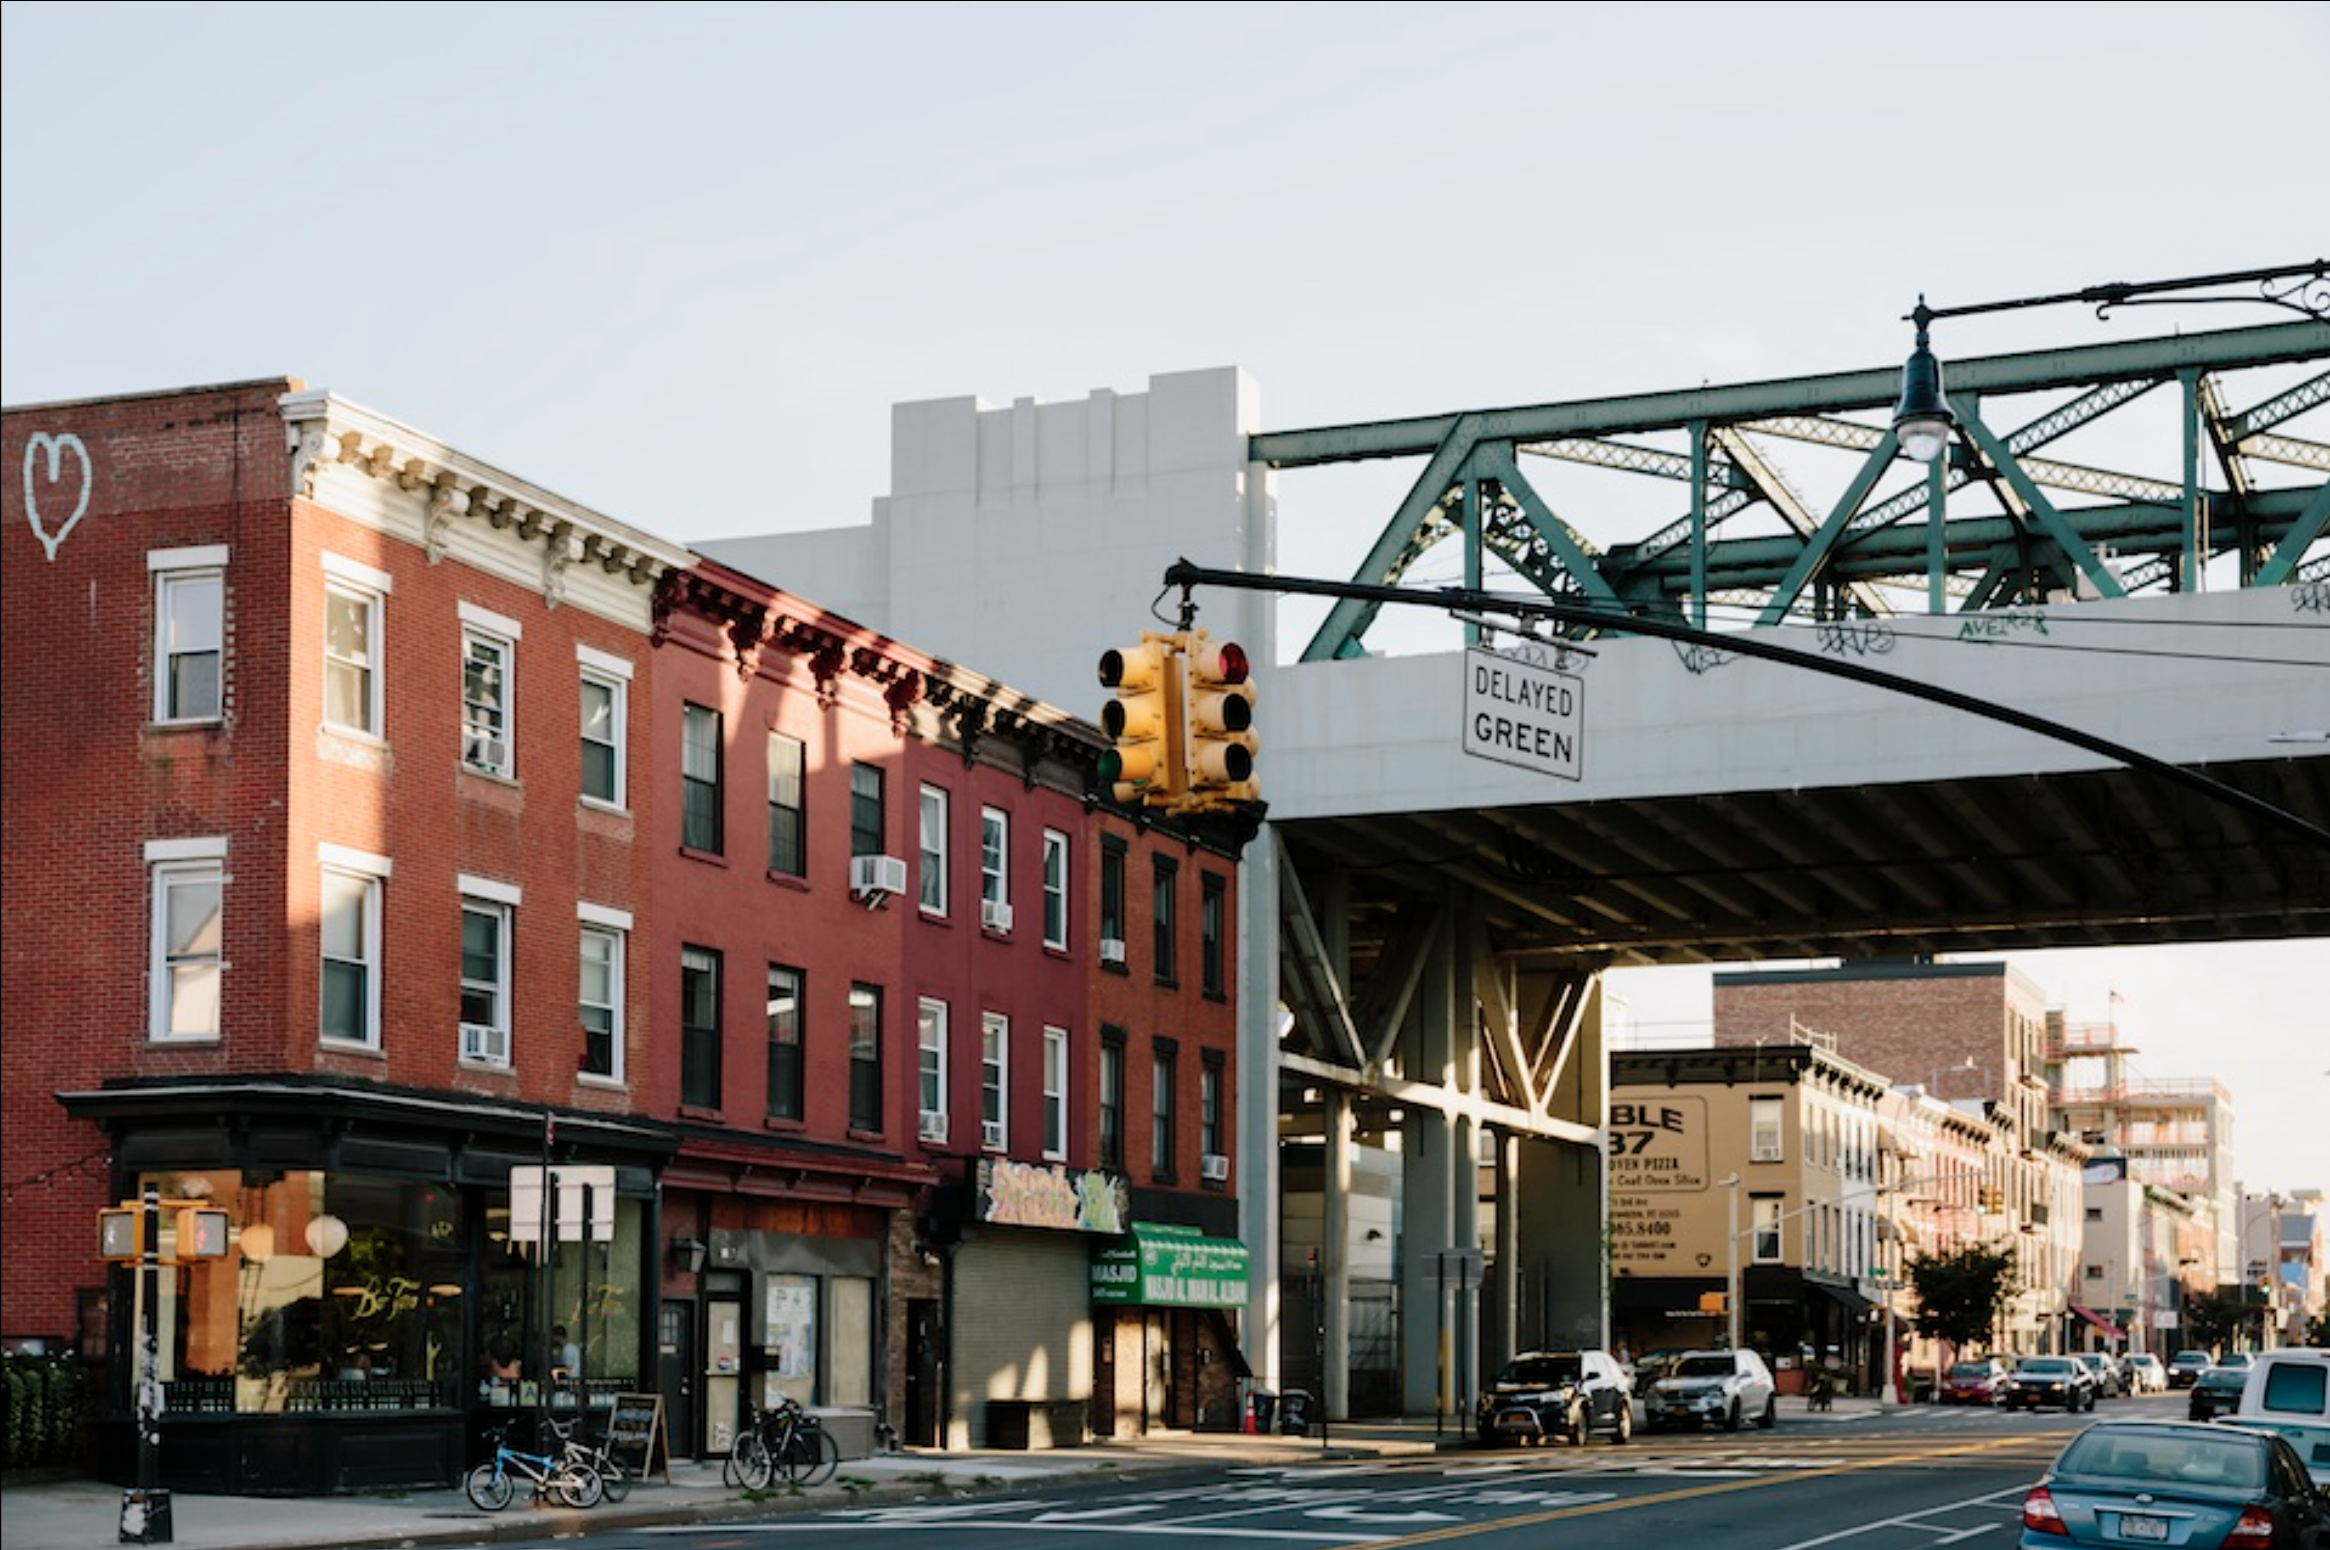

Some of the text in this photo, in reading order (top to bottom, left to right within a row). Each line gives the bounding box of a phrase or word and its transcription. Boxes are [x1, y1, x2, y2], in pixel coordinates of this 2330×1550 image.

[1475, 665, 1572, 717] DELAYED
[1475, 712, 1572, 763] GREEN
[1643, 1158, 1679, 1171] PIZZA
[1092, 1265, 1137, 1283] MASJID
